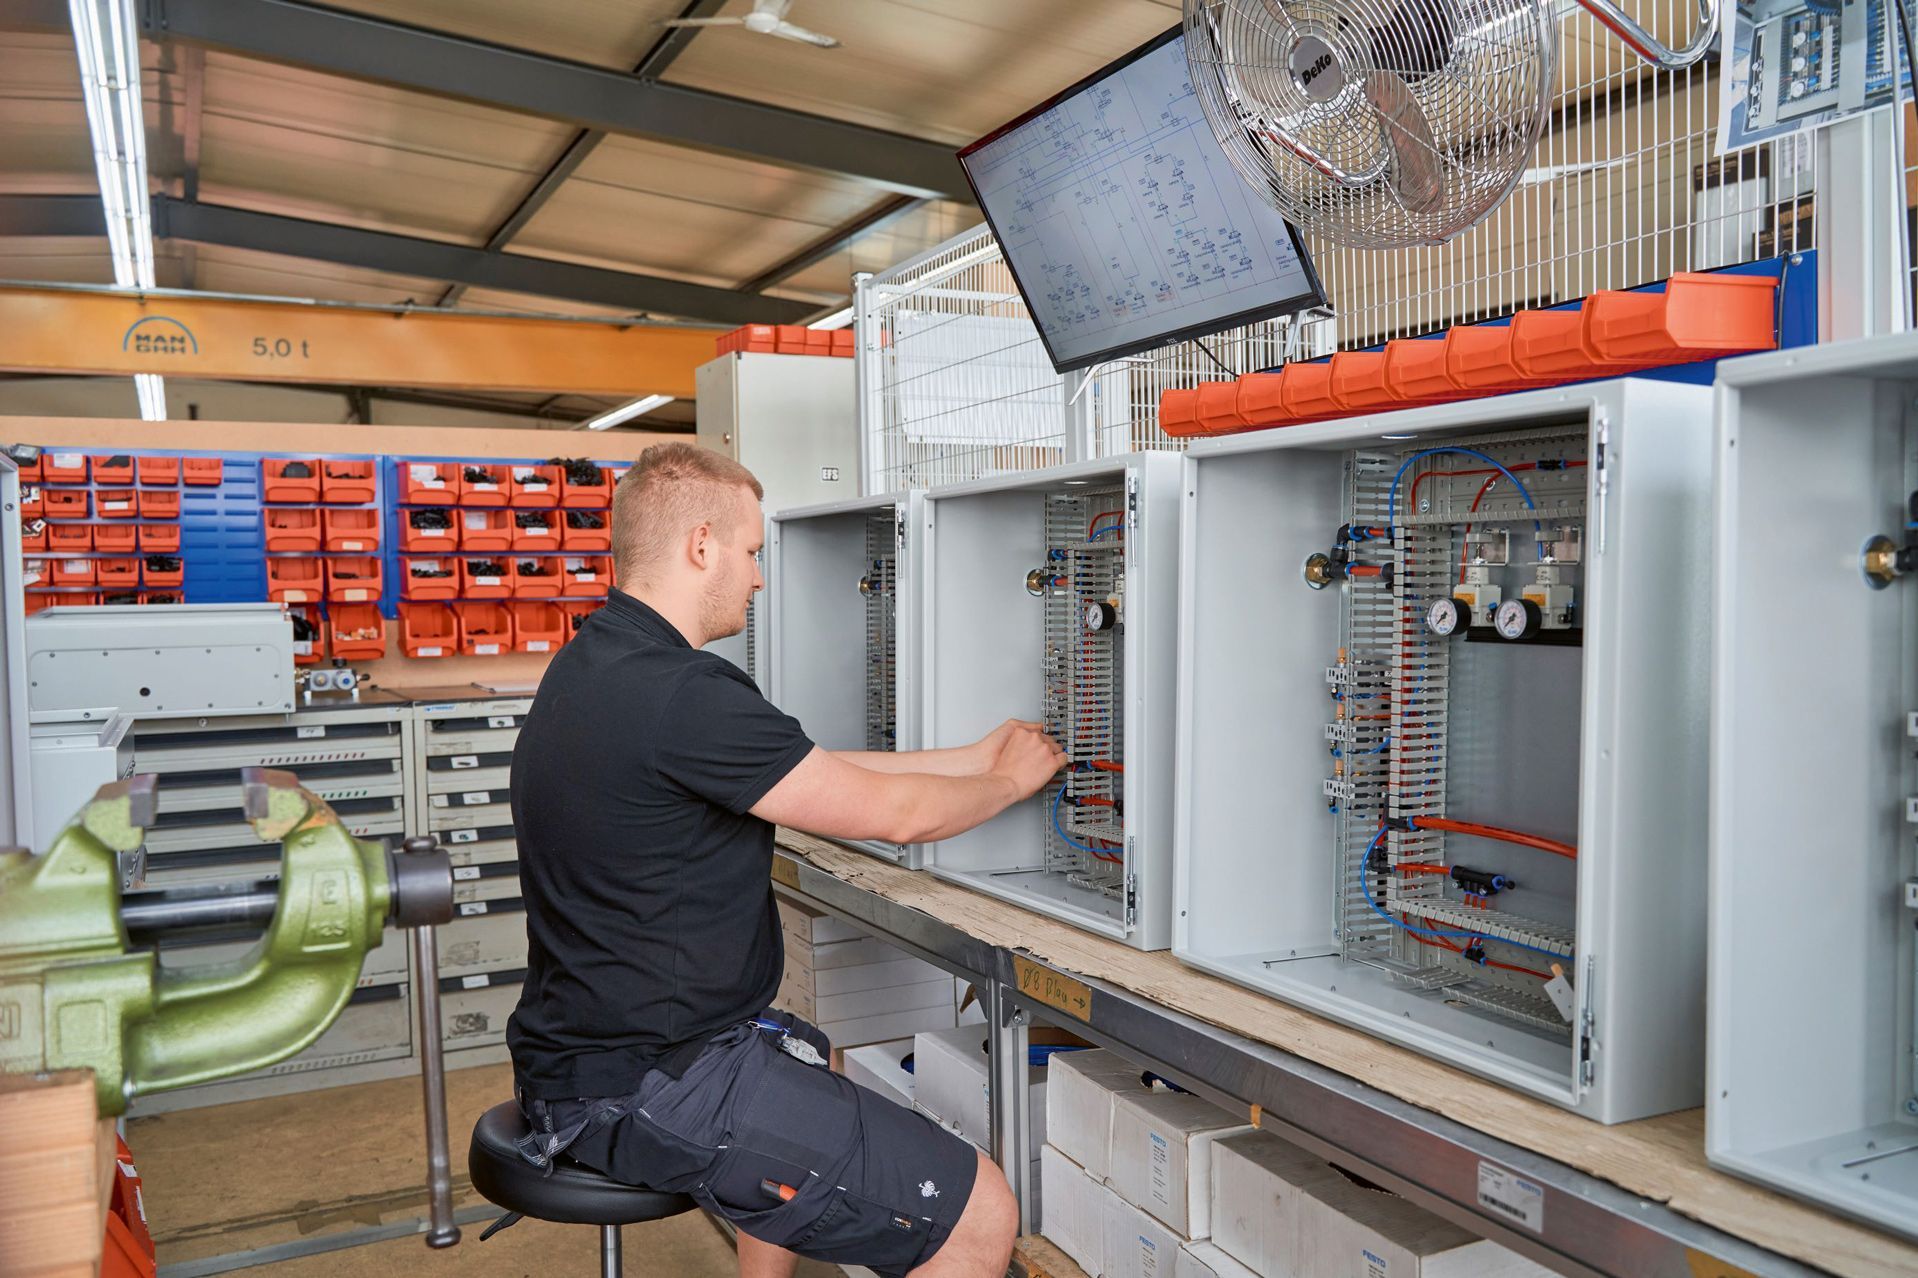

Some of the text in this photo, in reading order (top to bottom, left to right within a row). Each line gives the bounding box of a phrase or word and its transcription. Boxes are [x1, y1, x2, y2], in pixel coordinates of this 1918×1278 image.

[1302, 54, 1331, 86] DeKo
[136, 334, 185, 343] MAN
[136, 344, 186, 354] GHH
[253, 337, 310, 358] 5,0 t
[822, 469, 838, 480] EFS
[1150, 1132, 1167, 1148] FESTO
